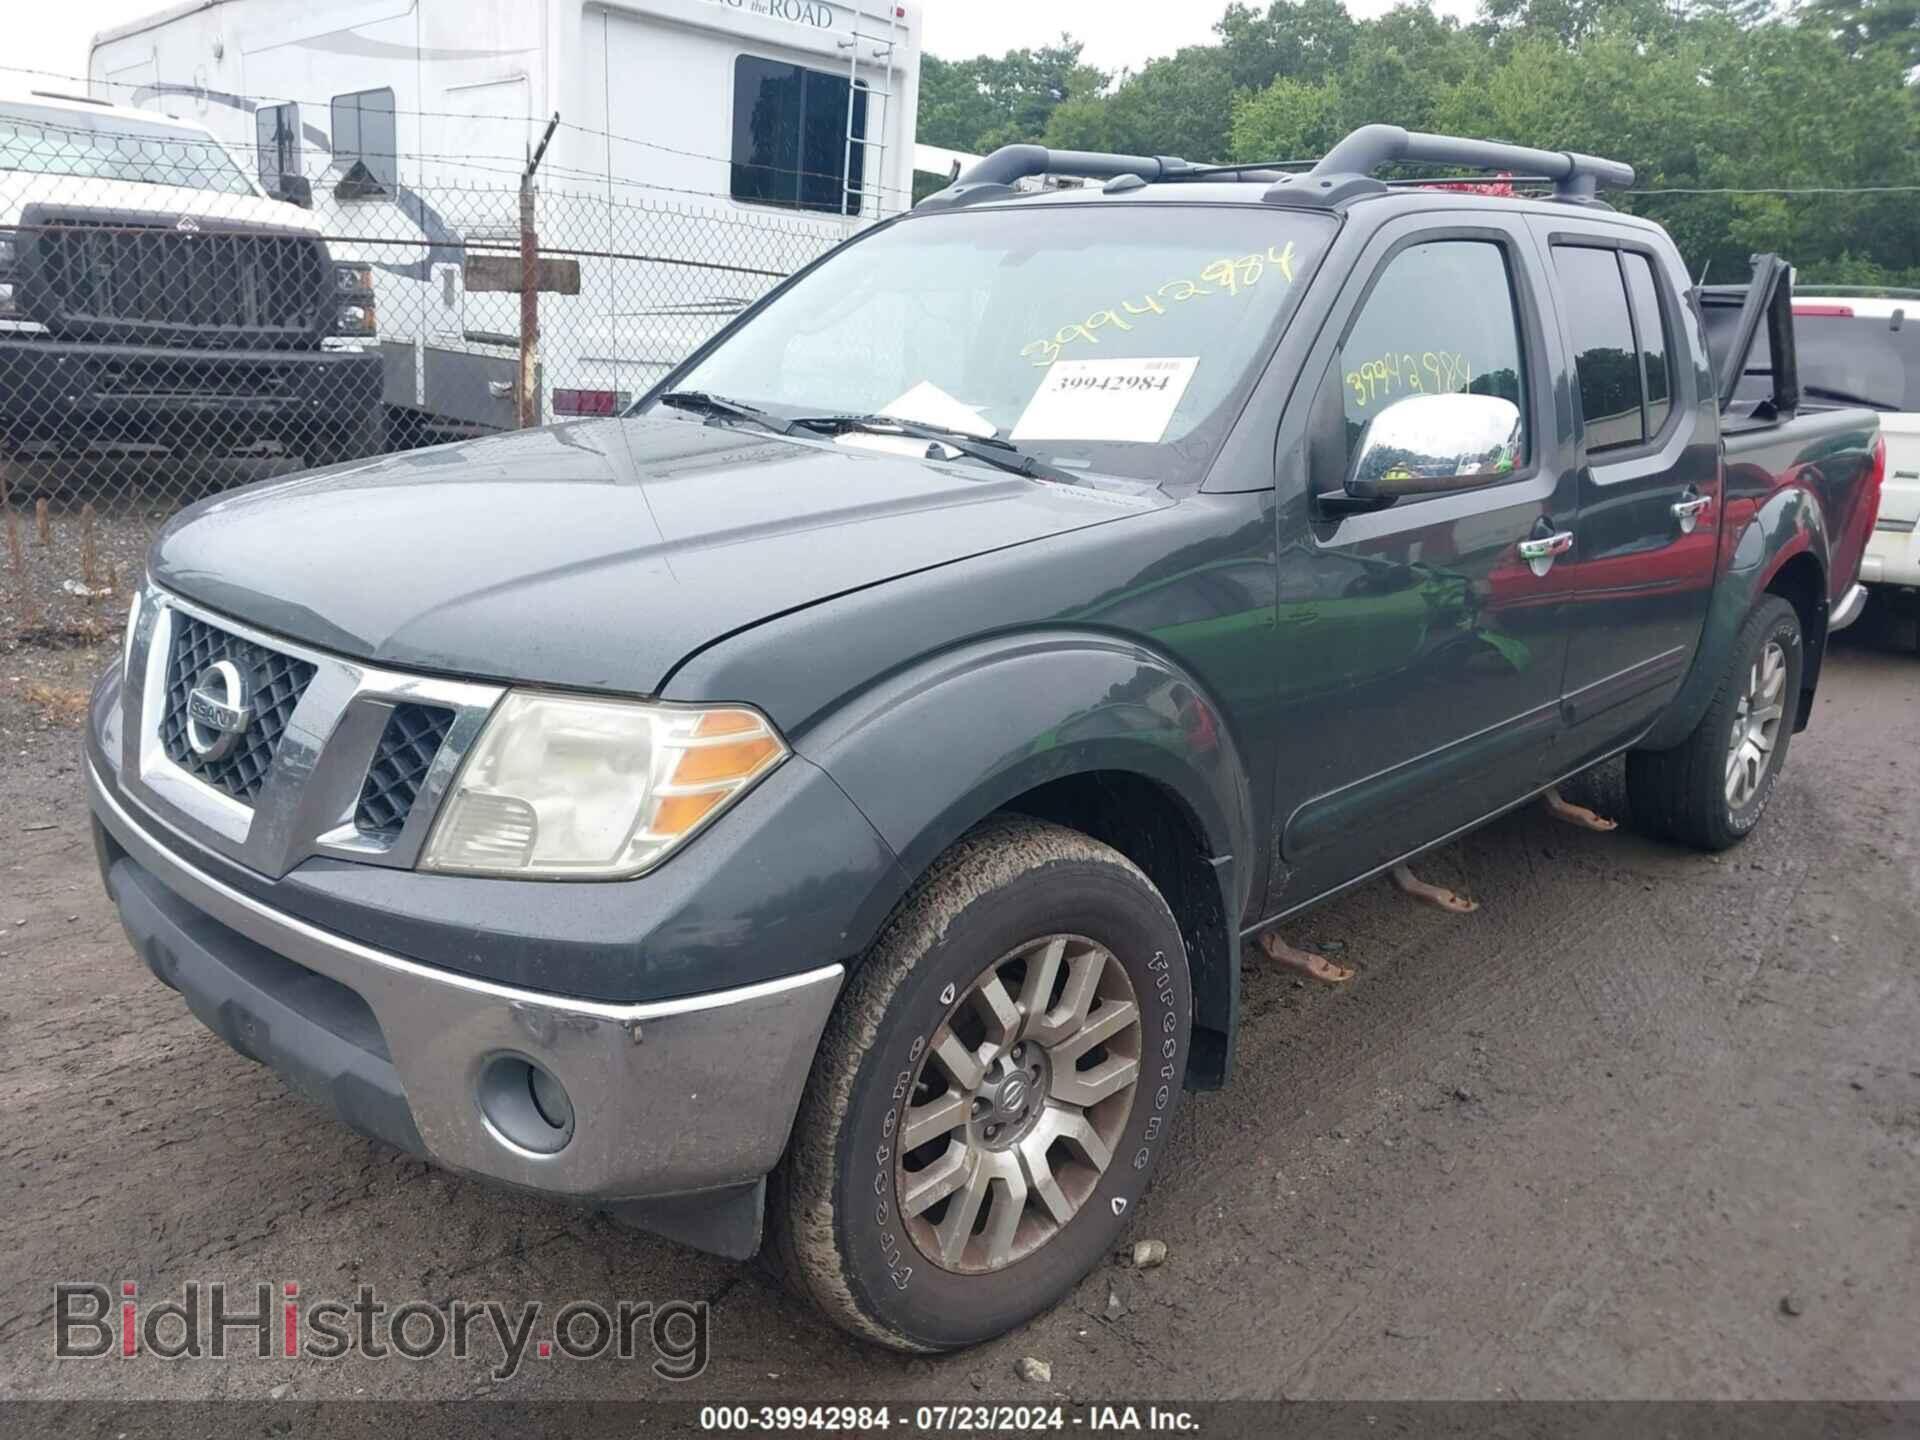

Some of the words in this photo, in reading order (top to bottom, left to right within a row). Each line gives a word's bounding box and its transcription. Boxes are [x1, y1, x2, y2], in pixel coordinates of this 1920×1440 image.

[769, 0, 832, 28] ROAD
[1020, 241, 1293, 367] 39942984
[1053, 376, 1170, 391] 39942984
[1134, 950, 1178, 1170] Firestone
